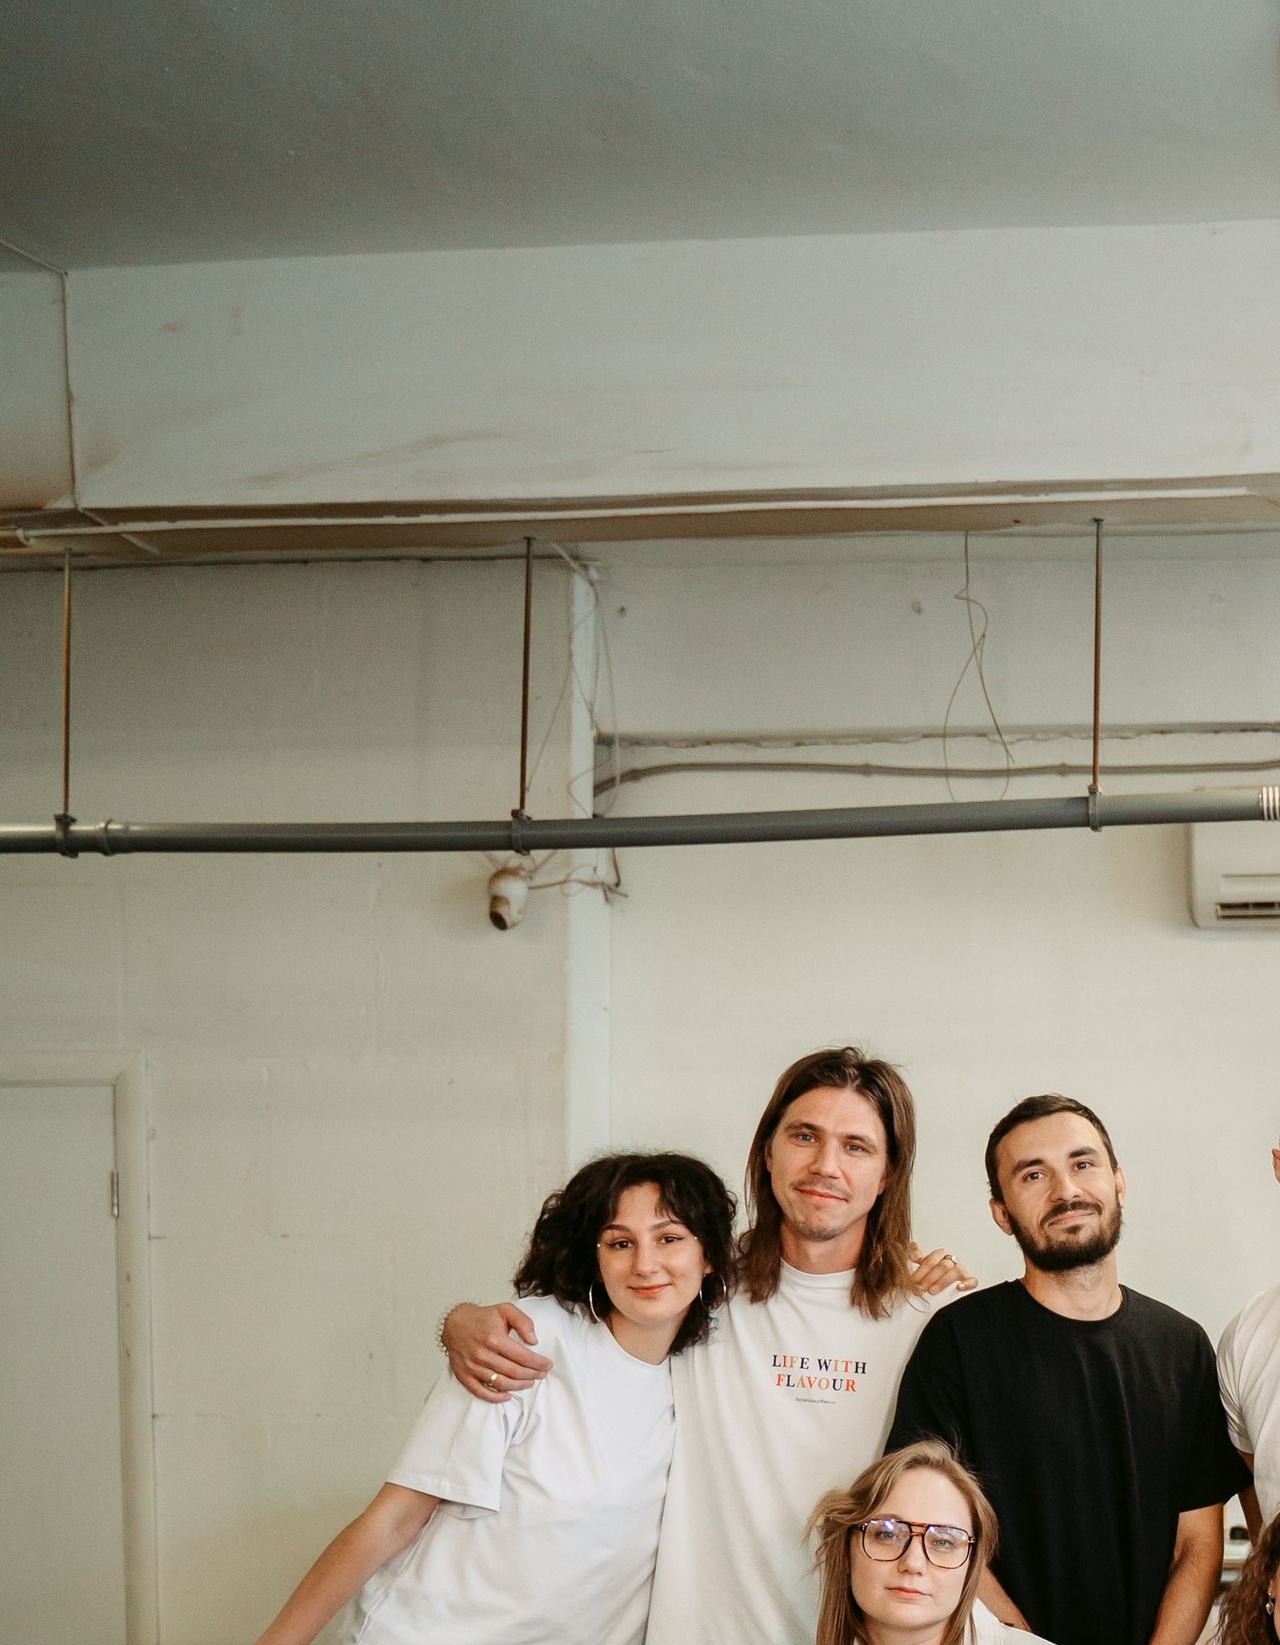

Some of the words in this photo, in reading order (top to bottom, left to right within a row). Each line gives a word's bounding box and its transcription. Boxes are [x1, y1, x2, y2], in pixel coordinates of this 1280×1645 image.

[772, 1354, 810, 1370] LIFE
[817, 1358, 867, 1375] WITH
[776, 1373, 857, 1393] FLAVOUR
